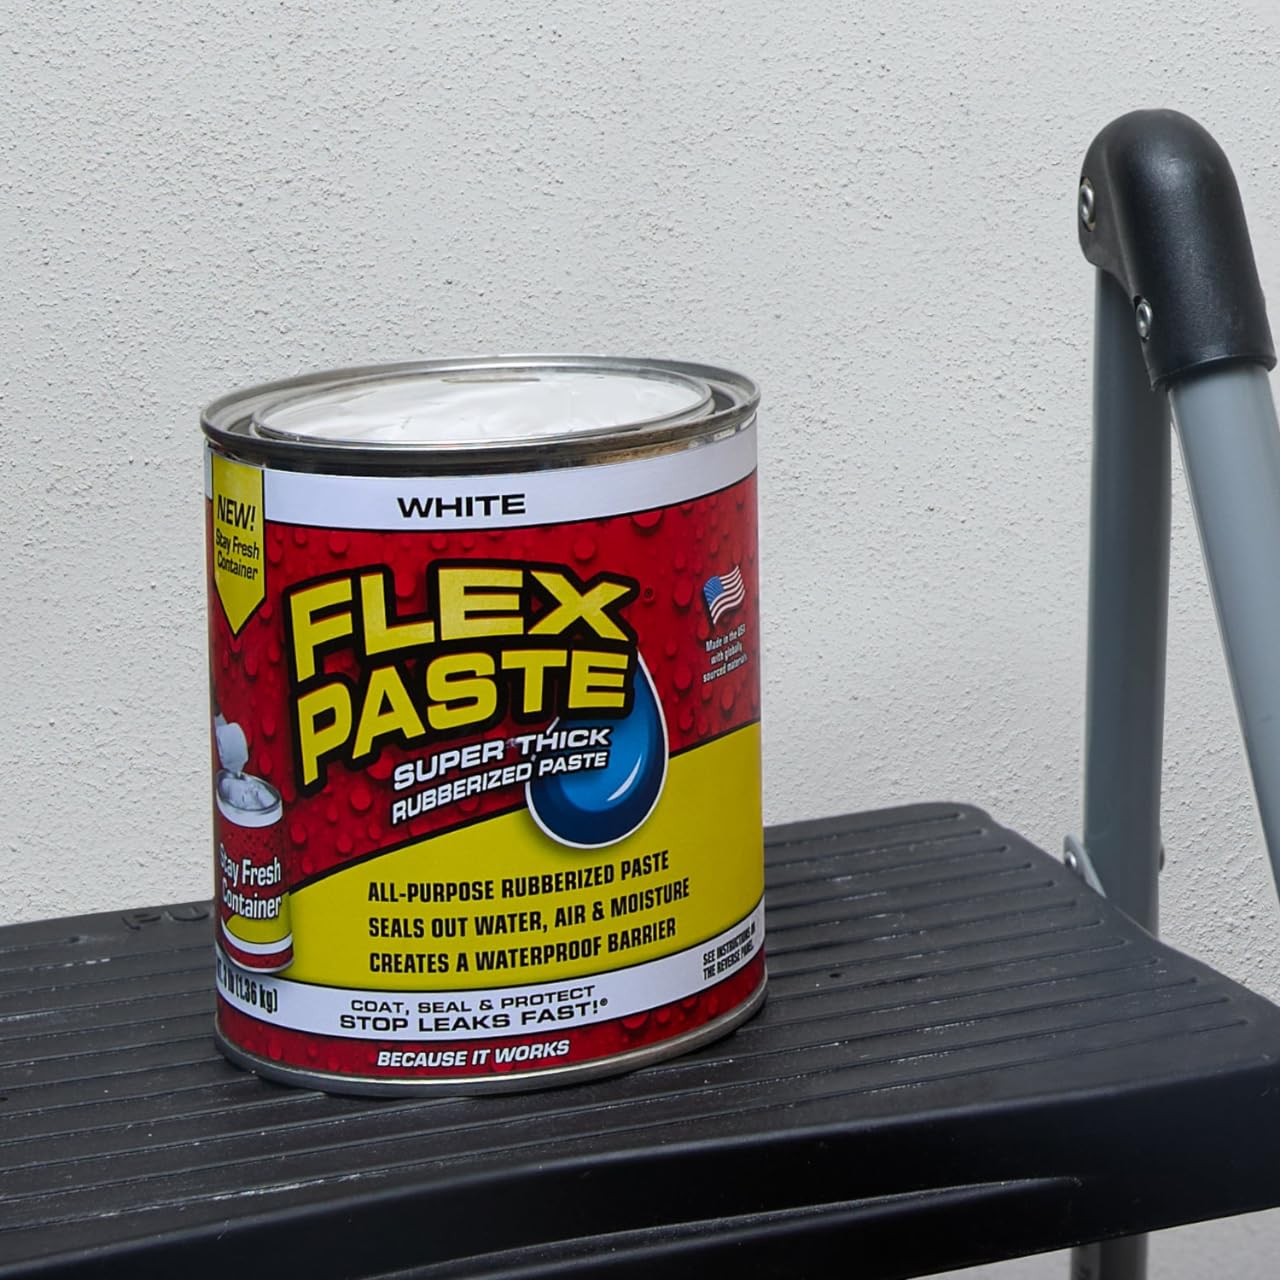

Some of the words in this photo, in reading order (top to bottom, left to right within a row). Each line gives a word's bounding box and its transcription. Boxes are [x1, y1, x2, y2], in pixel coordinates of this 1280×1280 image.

[217, 494, 256, 531] NEW!
[397, 494, 526, 518] WHITE
[216, 528, 231, 555] Stay
[233, 536, 259, 560] Fresh
[217, 550, 258, 580] Container
[289, 568, 631, 683] FLEX
[297, 649, 629, 787] PASTE
[394, 740, 505, 791] SUPER
[515, 728, 611, 755] THICK
[392, 762, 532, 824] RUBBERIZED
[538, 752, 608, 777] PASTE
[220, 843, 240, 887] Stay
[242, 856, 281, 887] Fresh
[368, 880, 494, 903] ALL-PURPOSE
[501, 864, 615, 898] RUBBERIZED
[621, 850, 669, 881] PASTE
[222, 877, 282, 919] Container
[369, 917, 424, 938] SEALS
[431, 917, 468, 938] OUT
[474, 911, 548, 936] WATER,
[554, 904, 586, 928] AIR
[592, 901, 604, 922] &
[610, 877, 690, 919] MOISTURE
[369, 952, 449, 974] CREATES
[456, 952, 469, 972] A
[475, 936, 602, 971] WATERPROOF
[607, 917, 676, 953] BARRIER
[236, 974, 257, 1006] (1.36
[260, 984, 278, 1014] kg)
[351, 1000, 410, 1015] COAT,
[418, 1001, 472, 1013] SEAL
[479, 999, 493, 1010] &
[501, 985, 595, 1009] PROTECT
[340, 1014, 408, 1032] STOP
[418, 1014, 510, 1032] LEAKS
[377, 1051, 467, 1067] BECAUSE
[472, 1049, 491, 1065] IT
[495, 1039, 570, 1064] WORKS
